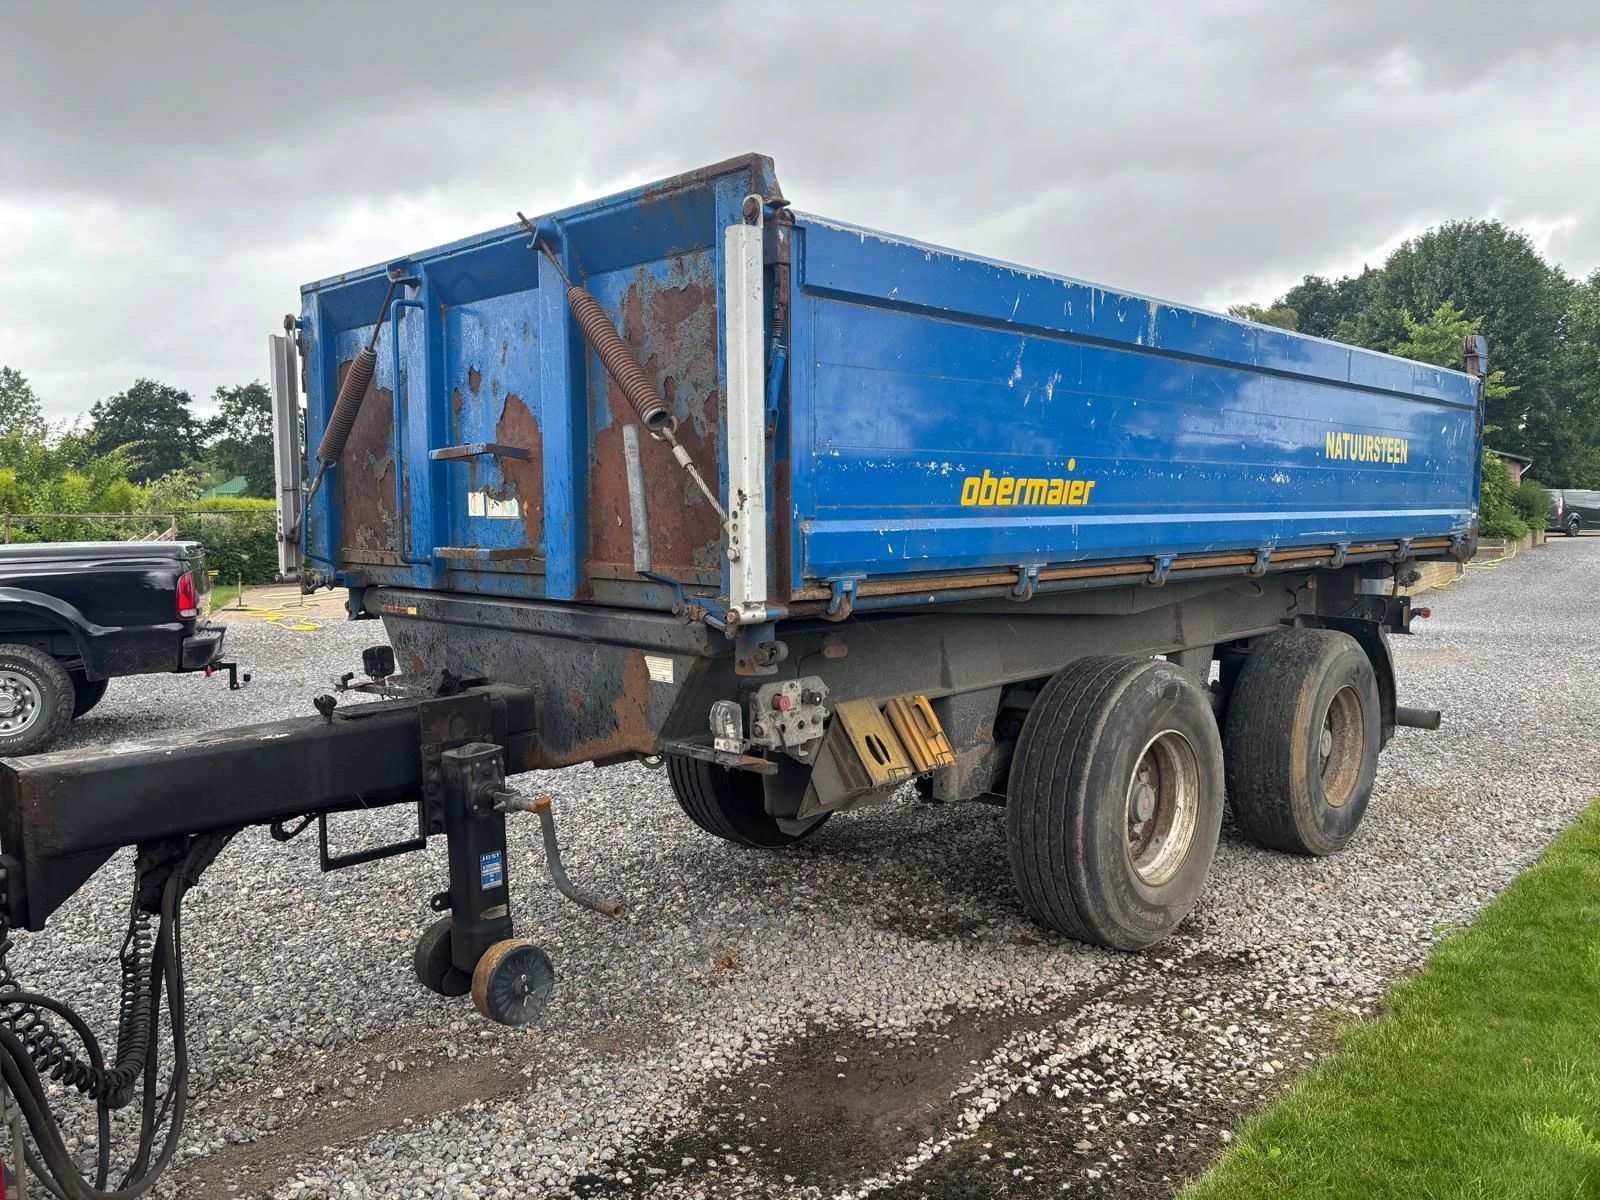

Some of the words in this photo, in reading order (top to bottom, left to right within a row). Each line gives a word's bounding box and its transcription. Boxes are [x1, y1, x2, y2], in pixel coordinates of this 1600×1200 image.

[1325, 431, 1408, 464] NATUURSTEEN
[960, 457, 1096, 506] obermaier
[481, 852, 500, 862] JOST
